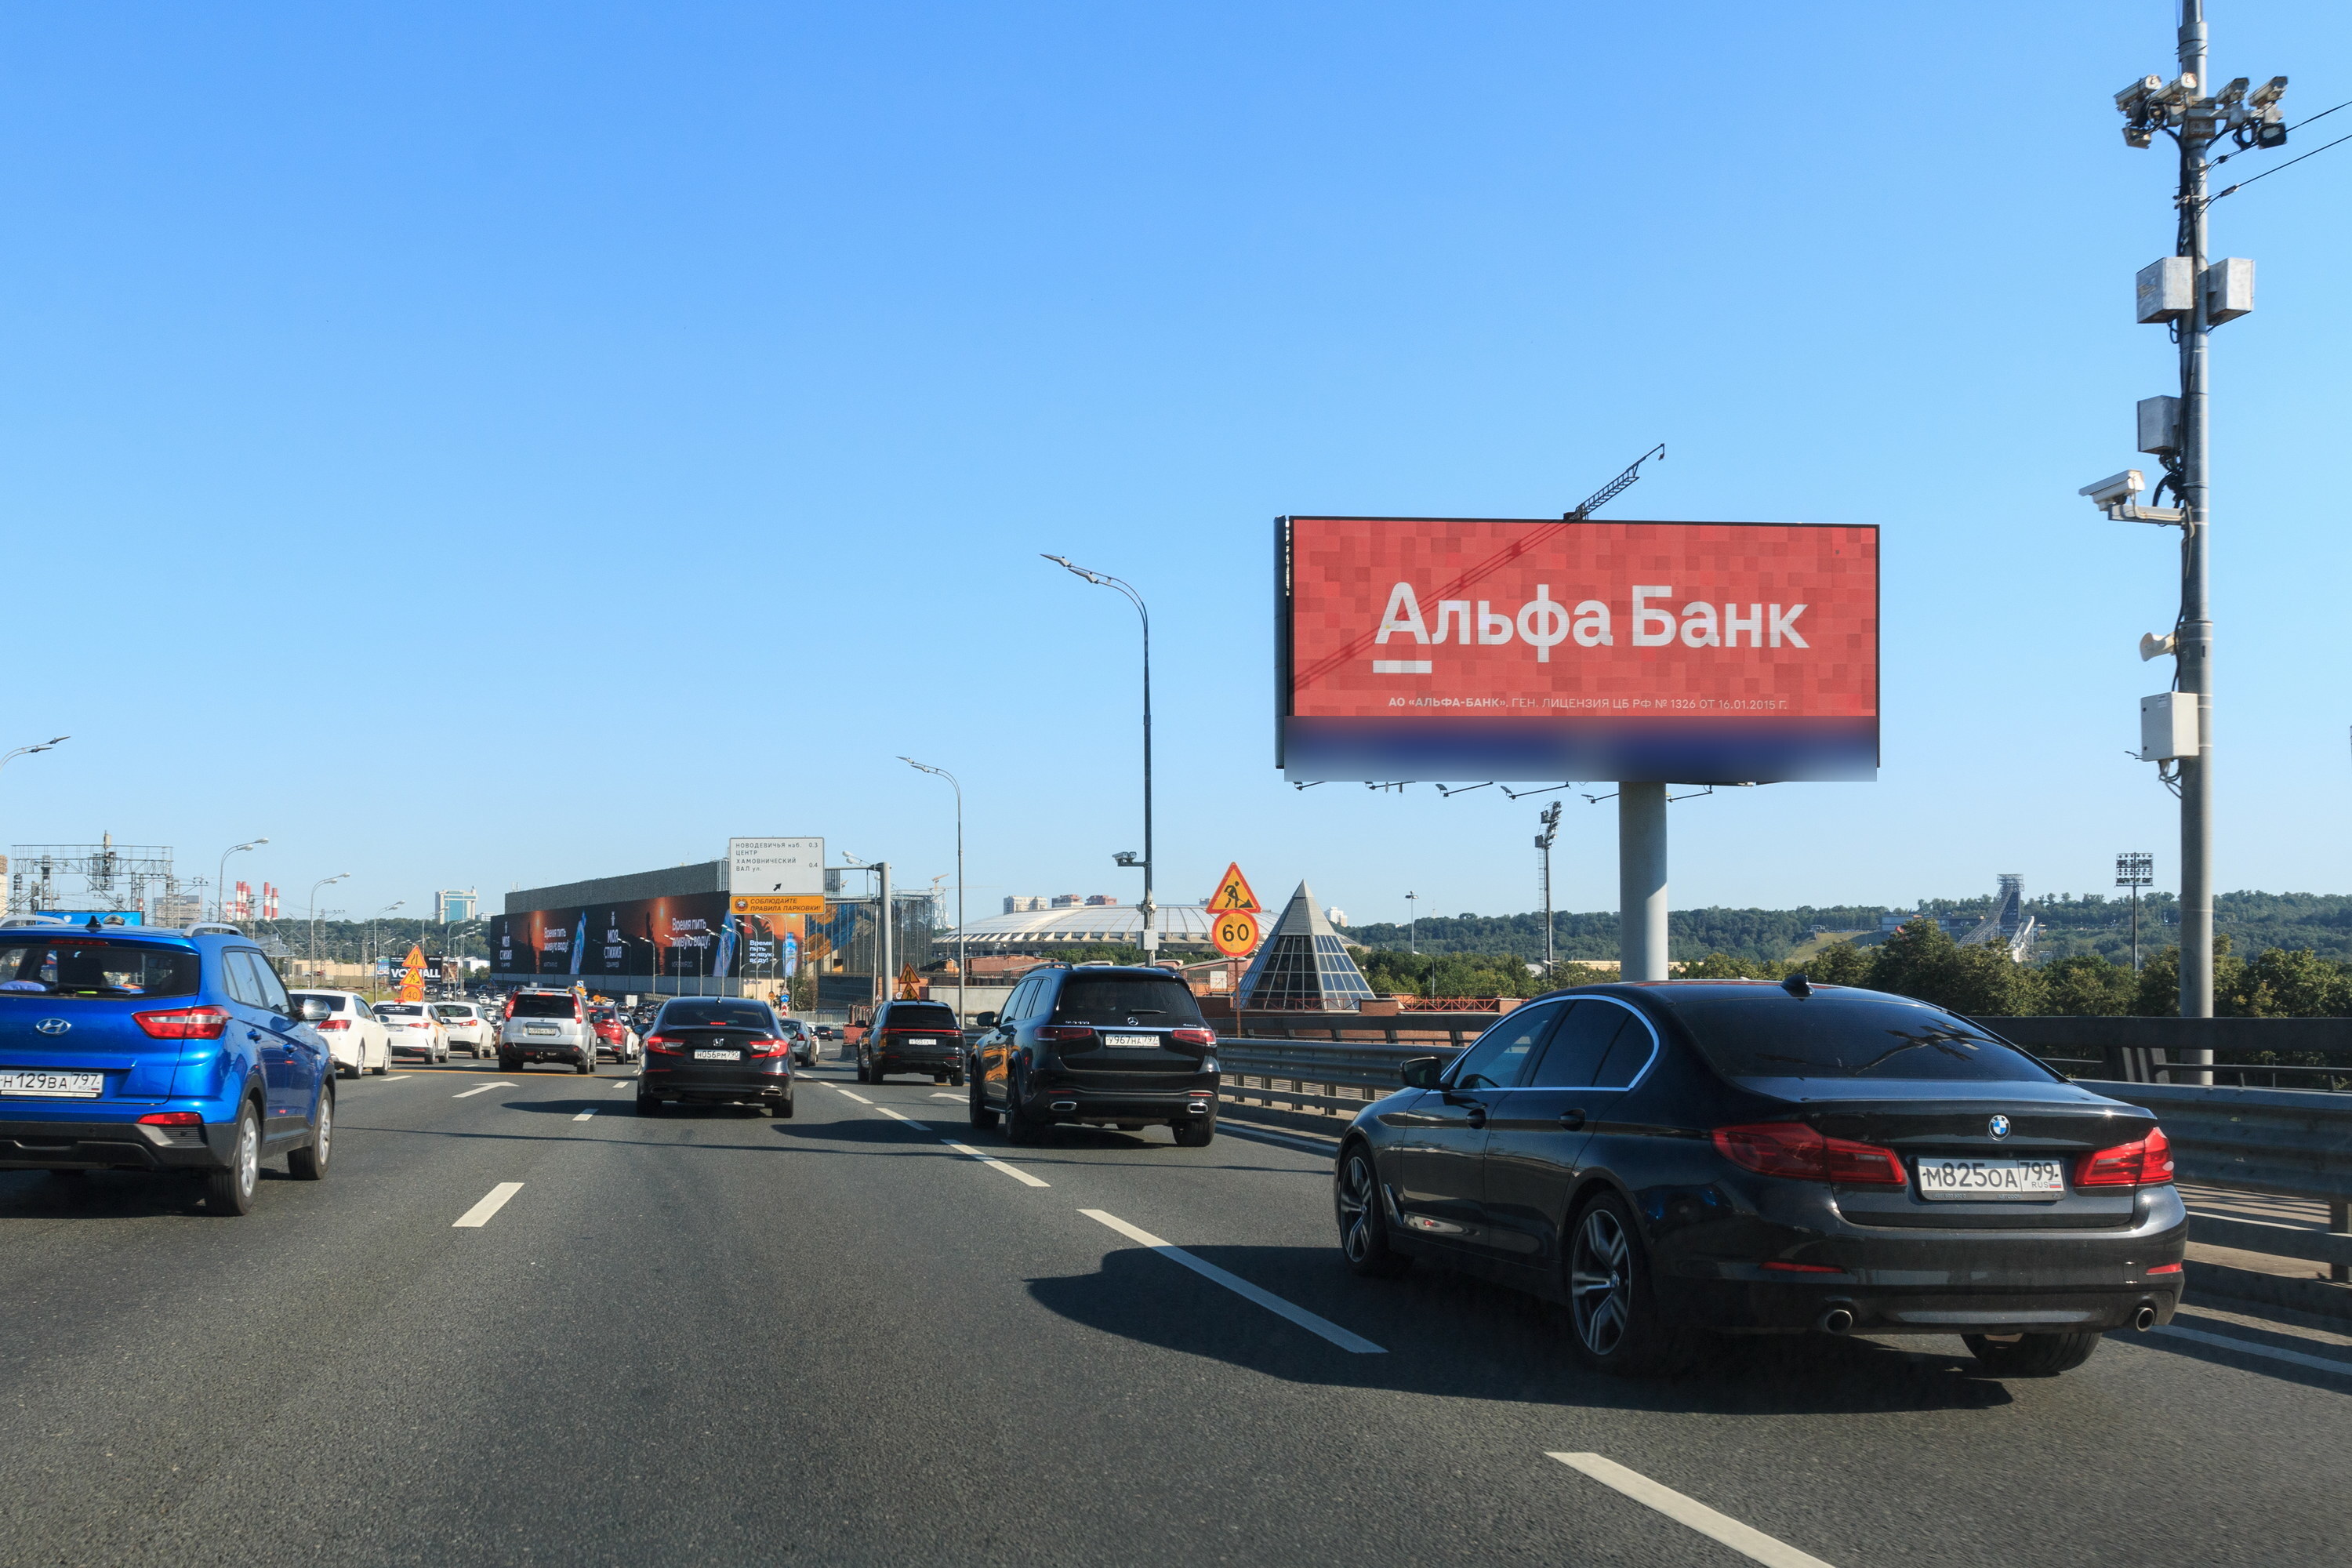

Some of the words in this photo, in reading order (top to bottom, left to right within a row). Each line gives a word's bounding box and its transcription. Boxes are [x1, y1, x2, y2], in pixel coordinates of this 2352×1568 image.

[1374, 581, 1613, 663] Альфа
[1632, 585, 1810, 648] Банк
[1388, 697, 1405, 706] АО
[1512, 698, 1539, 708] ГЕН.
[1542, 699, 1610, 709] ЛИЦЕНЗИЯ
[1613, 699, 1629, 710] ЦБ
[1632, 699, 1652, 709] РФ
[1654, 699, 1668, 707] №
[1670, 699, 1696, 709] 1326
[1699, 699, 1715, 710] ОТ
[1718, 699, 1776, 710] 16.01.2015
[1778, 700, 1788, 710] Г.
[1222, 924, 1249, 942] 60
[406, 991, 418, 1000] 40
[3, 1073, 67, 1089] Н129ВА
[73, 1073, 98, 1086] 797
[1926, 1162, 2018, 1188] М825ОА
[2019, 1162, 2054, 1181] 799
